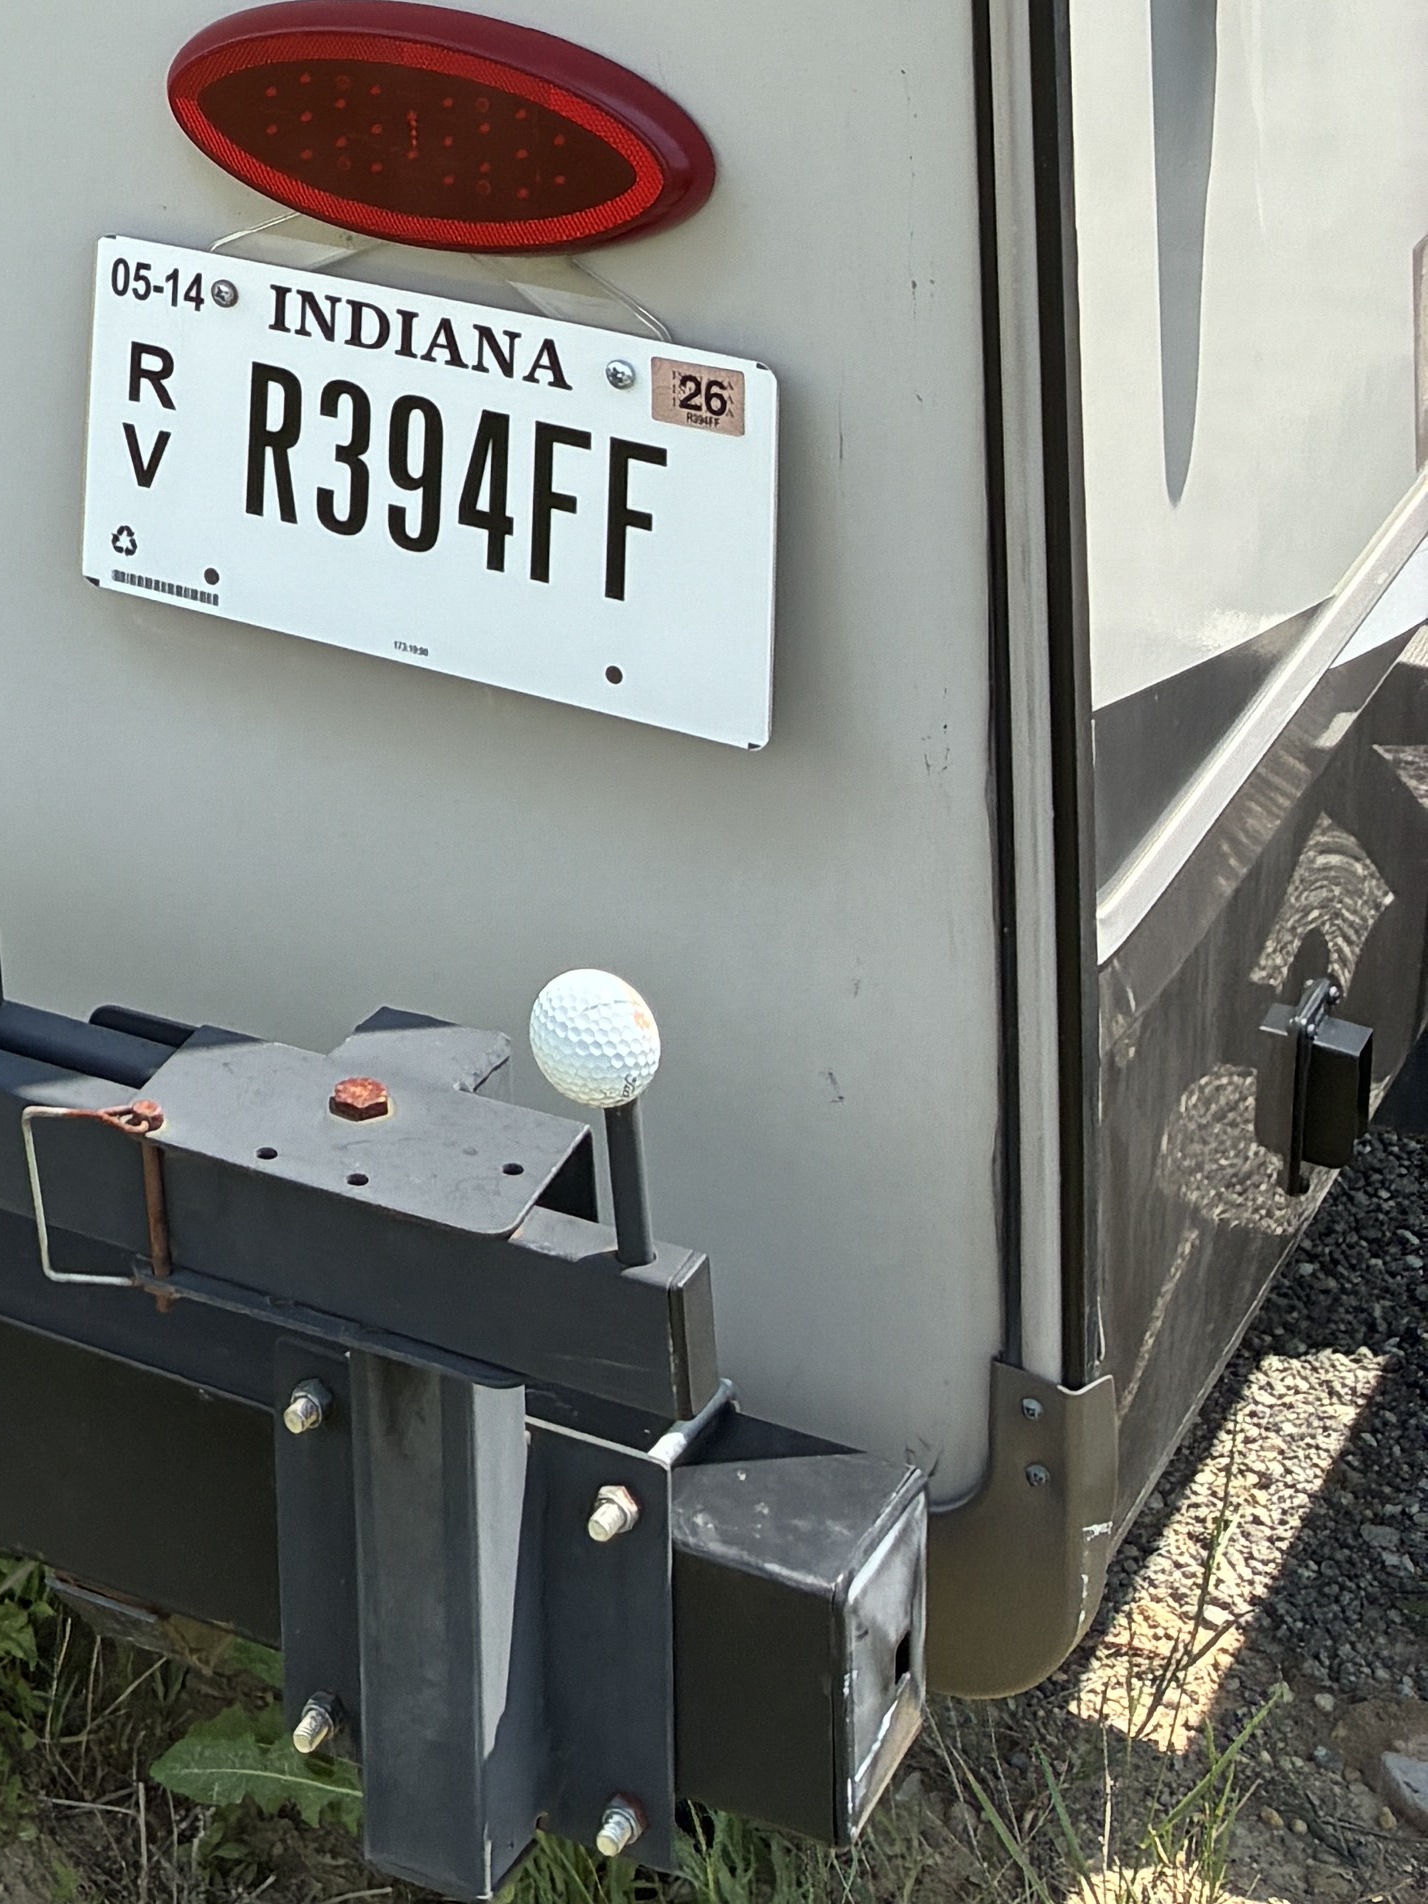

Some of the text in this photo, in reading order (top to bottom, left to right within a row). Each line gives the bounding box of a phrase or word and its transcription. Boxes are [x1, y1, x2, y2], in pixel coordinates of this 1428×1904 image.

[109, 256, 206, 312] 05-14
[268, 284, 574, 391] INDIANA
[678, 374, 728, 417] 26
[245, 360, 669, 603] R394FF
